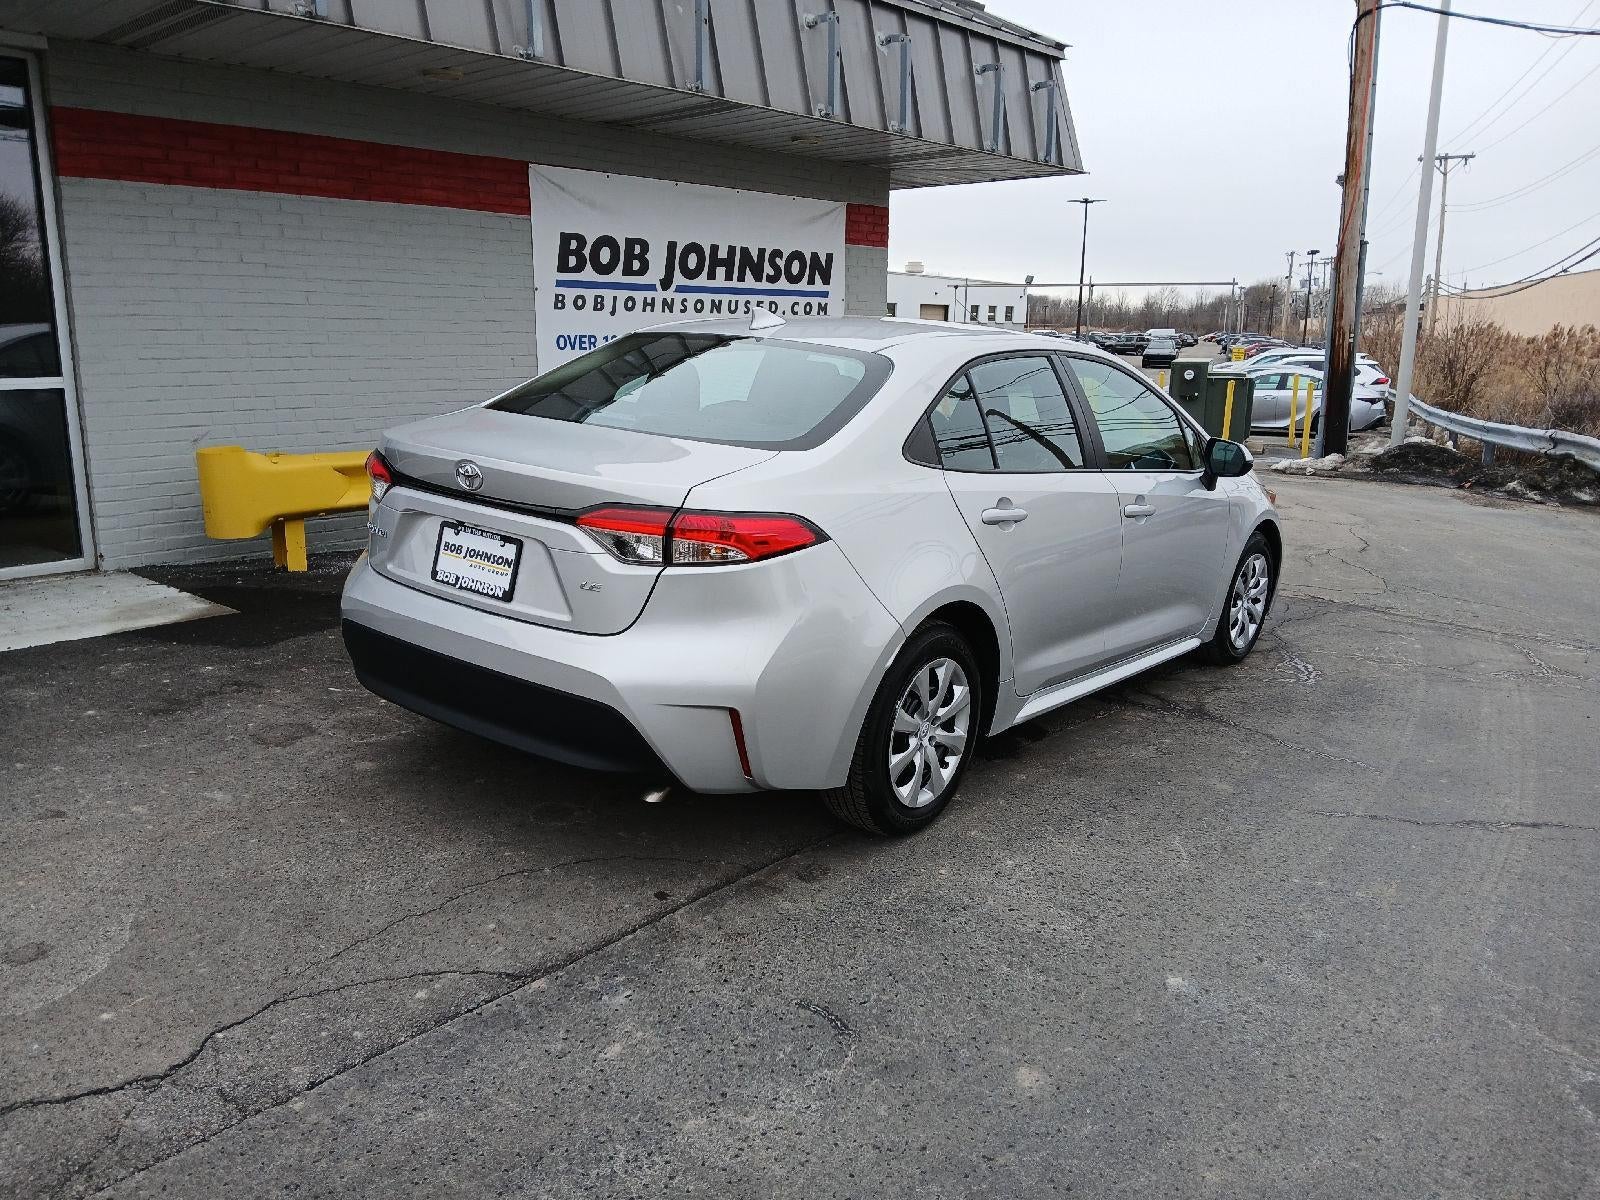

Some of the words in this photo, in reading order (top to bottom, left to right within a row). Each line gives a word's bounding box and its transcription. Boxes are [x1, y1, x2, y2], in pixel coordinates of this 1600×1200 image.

[556, 232, 650, 277] BOB
[659, 240, 834, 292] JOHNSON
[556, 334, 598, 351] OVER
[443, 541, 463, 555] BOB
[463, 546, 514, 569] JOHNSON
[436, 570, 457, 584] BOB
[456, 575, 505, 598] JOHNSON
[469, 563, 485, 571] AUTO
[487, 568, 509, 577] GROUP
